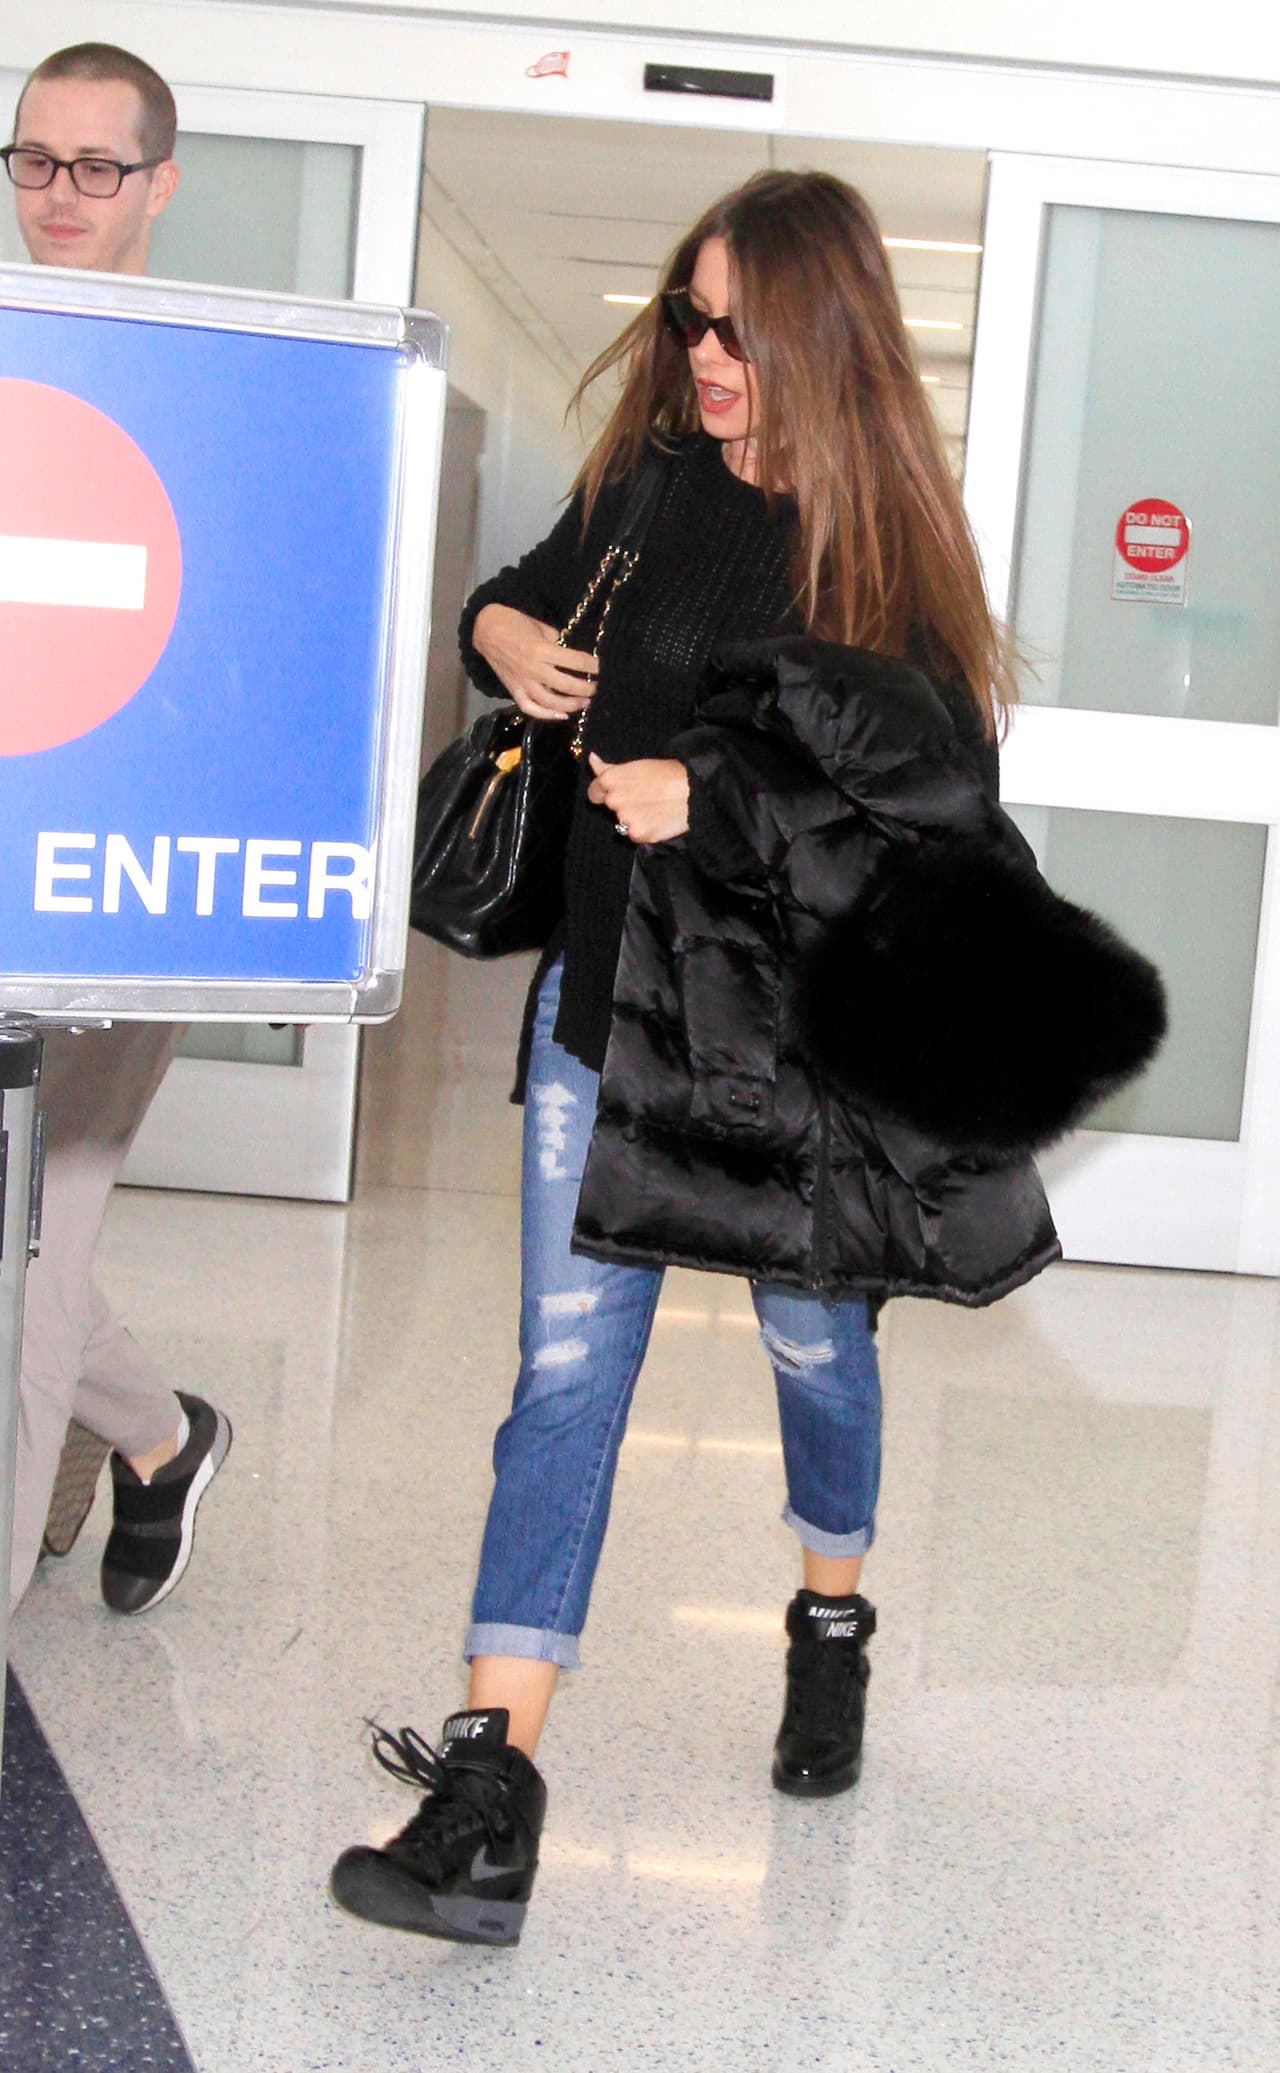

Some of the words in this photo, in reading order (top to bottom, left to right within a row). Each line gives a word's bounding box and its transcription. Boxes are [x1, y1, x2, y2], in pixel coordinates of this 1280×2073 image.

[1125, 512, 1147, 525] DO
[1151, 514, 1182, 527] NOT
[1127, 545, 1176, 560] ENTER
[34, 831, 374, 920] ENTER
[826, 1621, 858, 1637] NIKE
